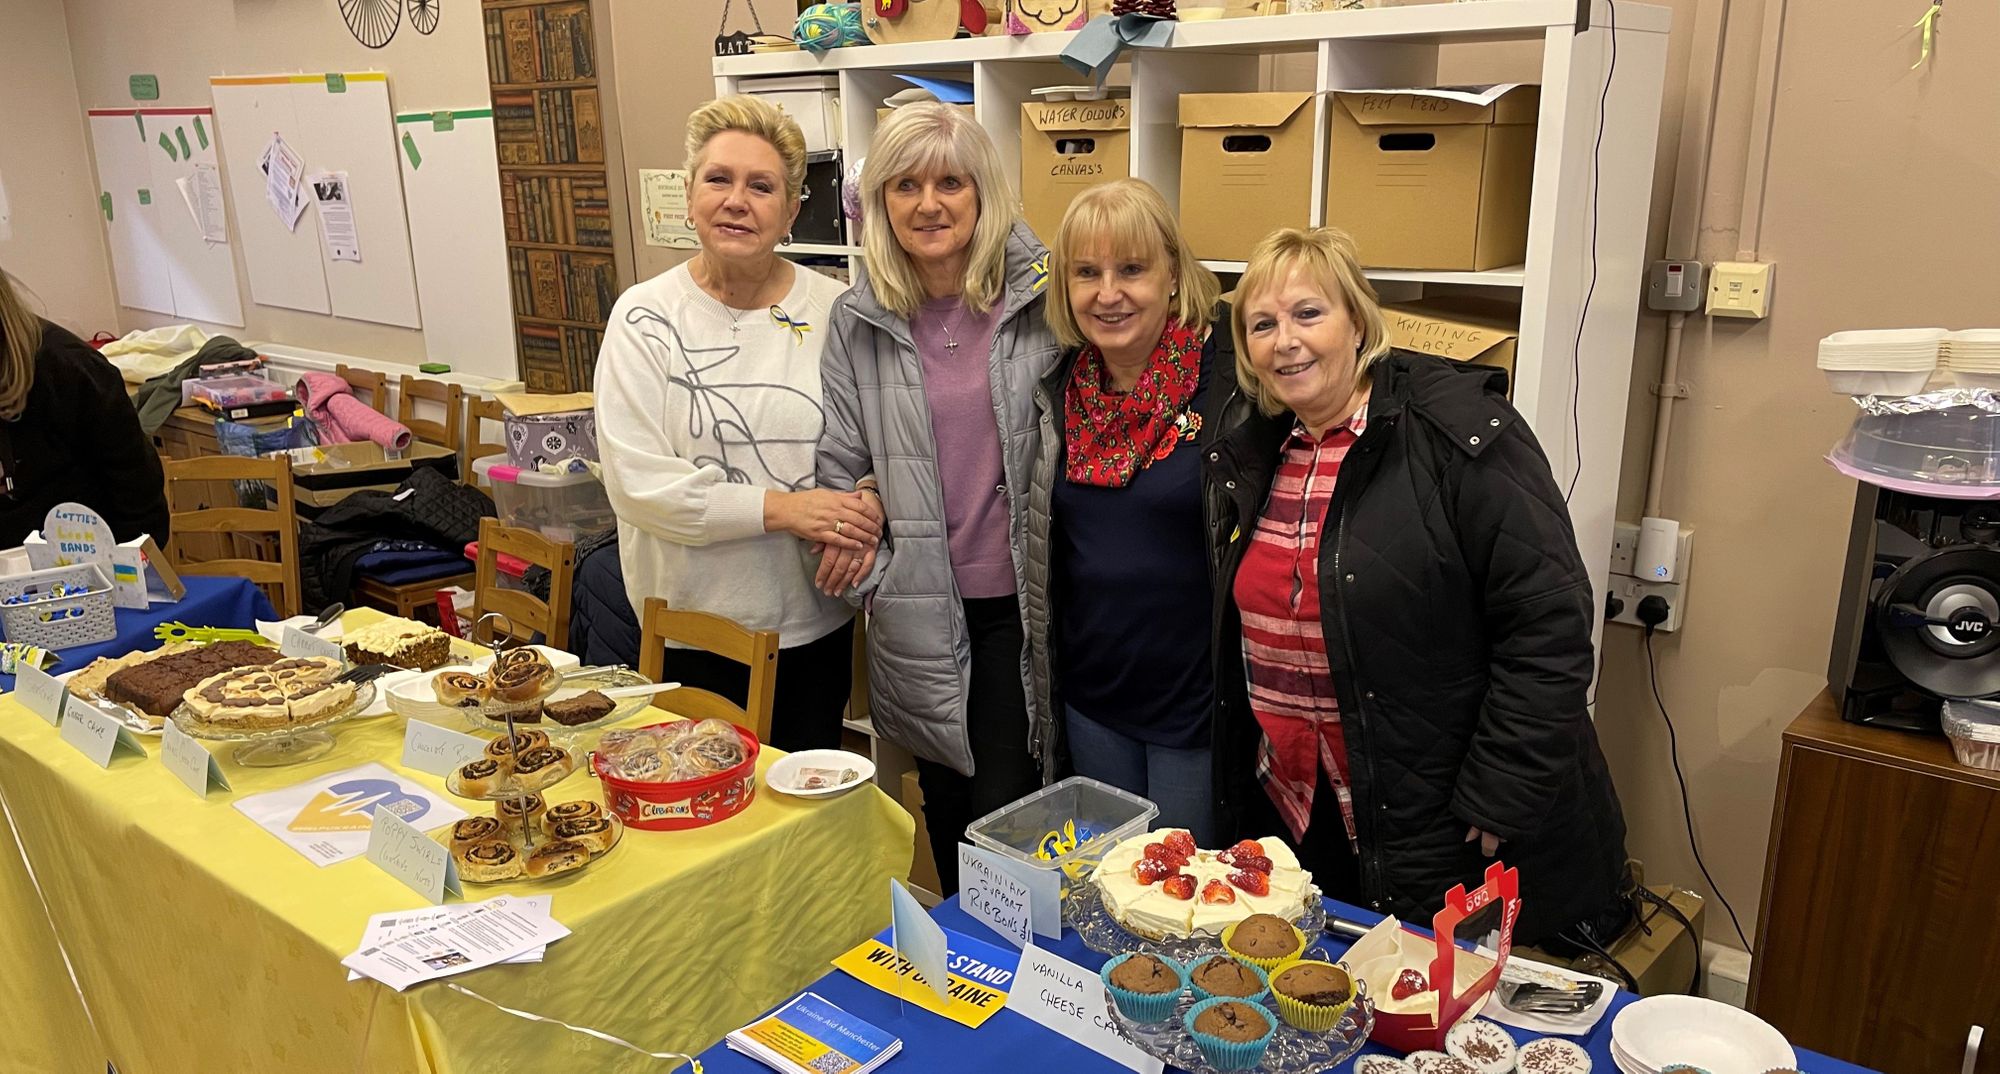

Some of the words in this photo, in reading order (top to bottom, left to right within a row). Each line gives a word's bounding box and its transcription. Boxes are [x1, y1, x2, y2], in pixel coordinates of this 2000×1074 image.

[718, 41, 753, 55] LATT
[1039, 107, 1077, 125] WATER
[1079, 104, 1126, 123] COLOURS
[1396, 316, 1482, 343] KNITTING
[1408, 337, 1456, 355] LACE
[55, 509, 98, 526] LOTTIE'S
[59, 542, 97, 555] BANDS
[1955, 620, 1984, 632] JVC
[381, 816, 408, 852] POPPY
[409, 834, 442, 866] SWIRLS
[962, 851, 1027, 897] UKRAINIAN
[967, 887, 1018, 933] RIBBONS
[980, 879, 1024, 912] SUPPORT
[866, 947, 914, 976] WITH
[948, 954, 1013, 985] STAND
[1032, 961, 1084, 993] VANILLA
[1040, 988, 1085, 1020] CHEESE
[796, 1004, 824, 1022] Ukraine
[823, 1019, 838, 1029] Aid
[837, 1025, 880, 1052] Manchester
